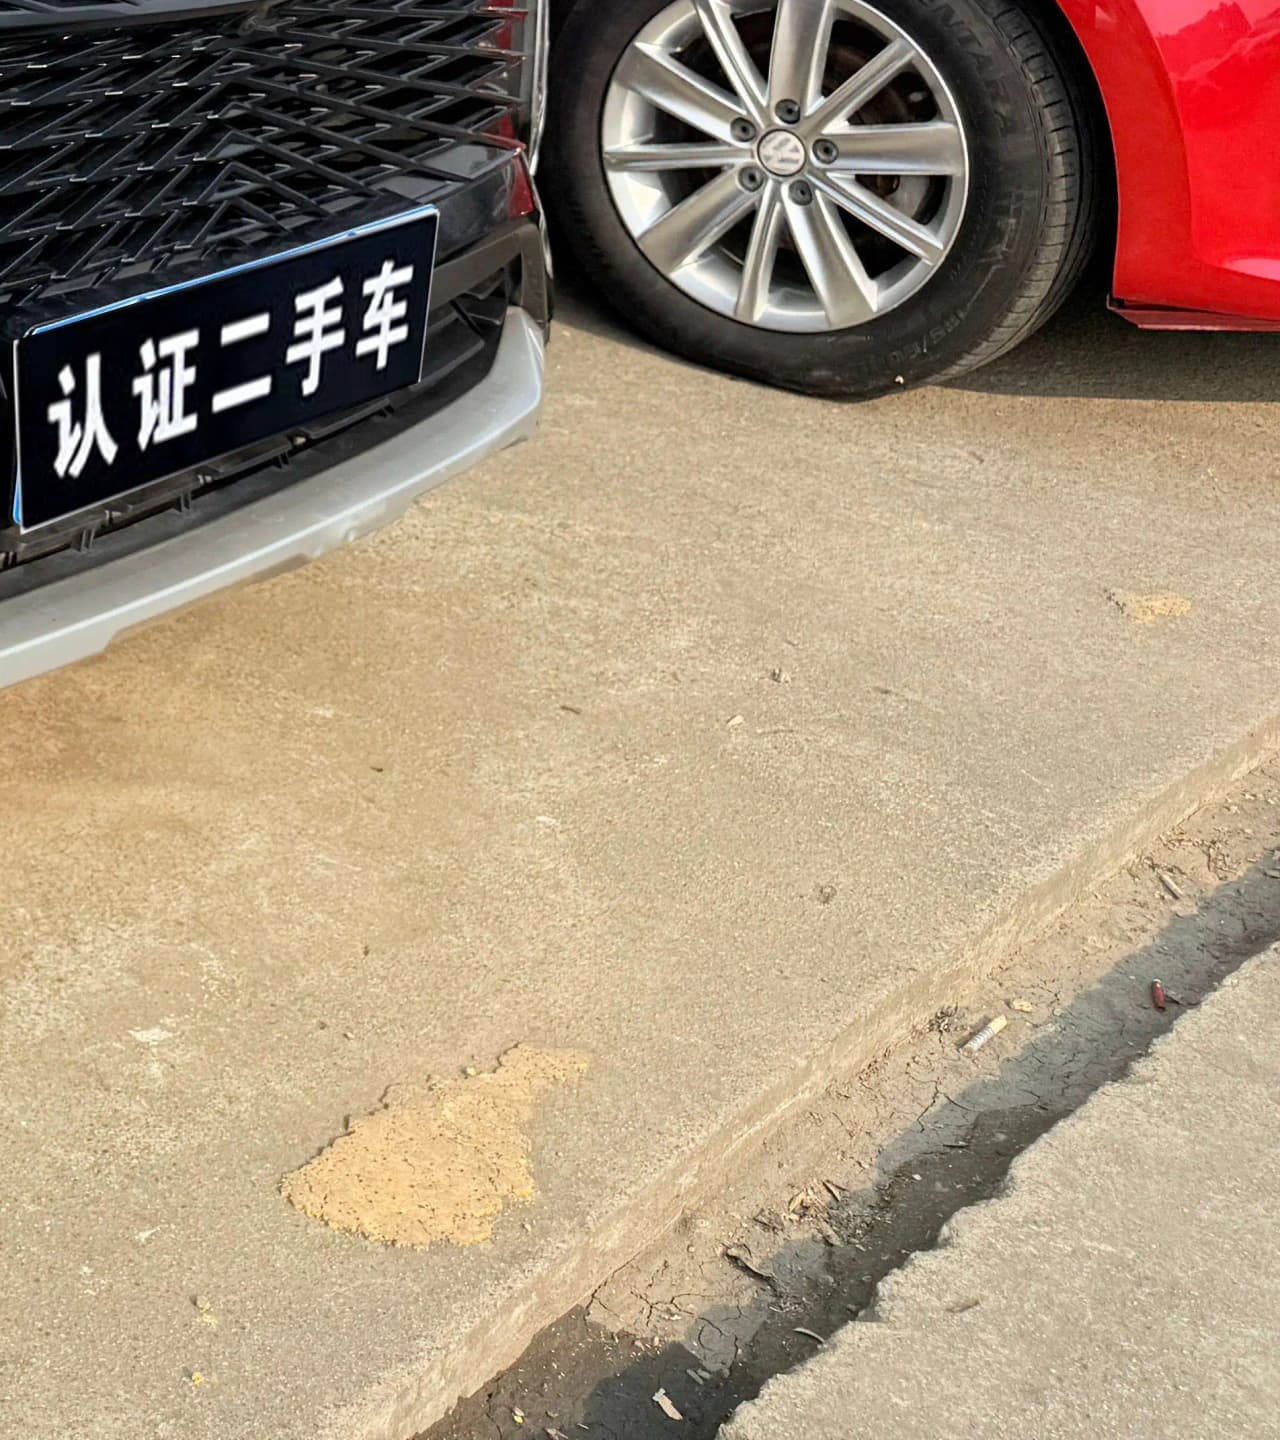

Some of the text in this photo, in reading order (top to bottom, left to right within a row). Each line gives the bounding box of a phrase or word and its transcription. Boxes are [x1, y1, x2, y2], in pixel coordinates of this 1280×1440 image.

[47, 259, 415, 479] 认证二手车
